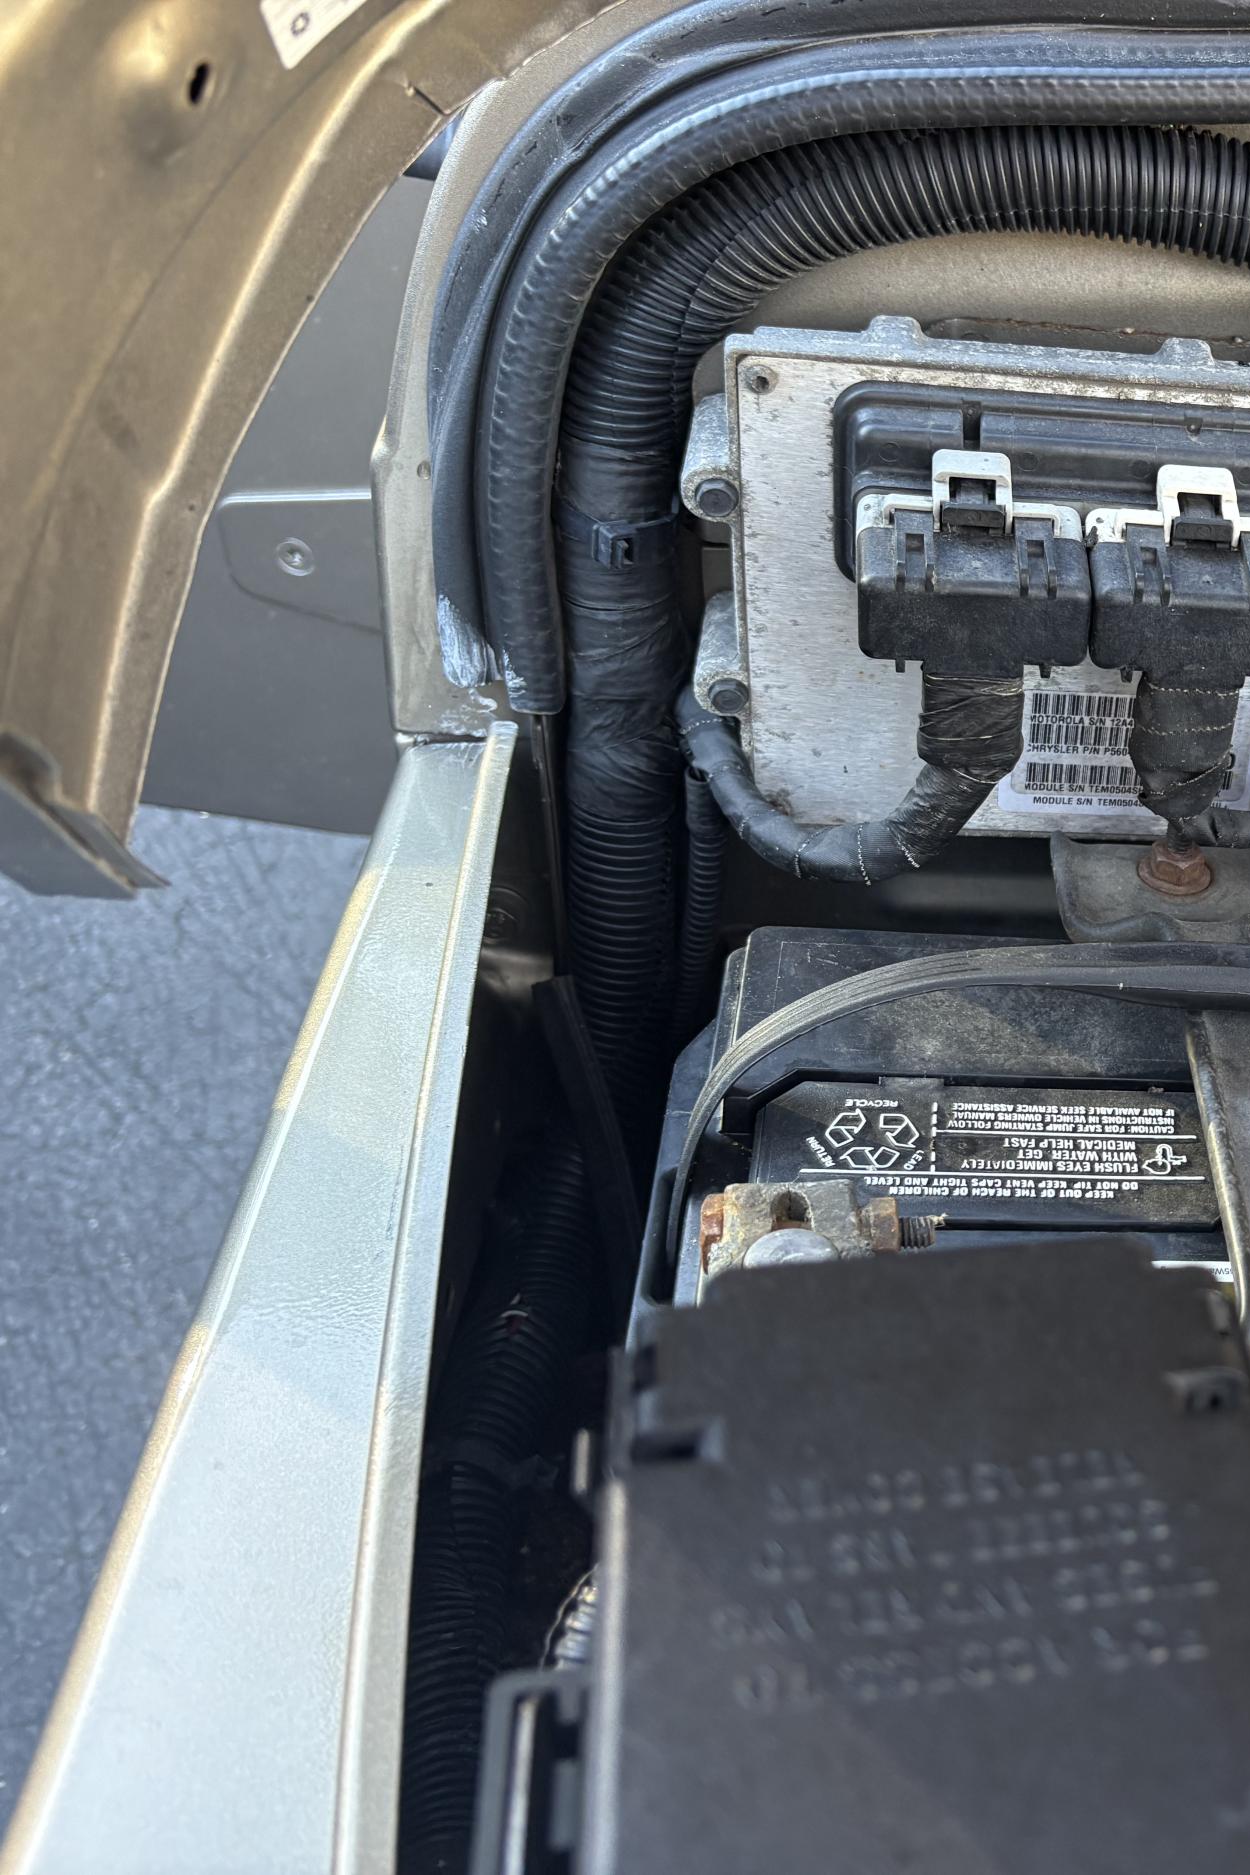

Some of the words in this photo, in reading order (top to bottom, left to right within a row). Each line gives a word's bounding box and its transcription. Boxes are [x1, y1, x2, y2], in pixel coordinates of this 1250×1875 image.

[1030, 715, 1084, 725] MOTOROLA
[1089, 717, 1106, 726] S/N
[1083, 746, 1100, 756] P/N
[1025, 783, 1064, 792] MODULE
[1068, 784, 1085, 793] S/N
[1033, 796, 1074, 806] MODULE
[1076, 797, 1093, 806] S/N
[844, 1098, 898, 1108] RECYCLE
[952, 1102, 1014, 1112] ASSISTANCE
[1016, 1104, 1058, 1113] SERVICE
[1060, 1106, 1086, 1114] SEEK
[1088, 1106, 1140, 1115] AVAILABLE
[1142, 1108, 1163, 1116] NOT
[1164, 1108, 1174, 1116] IF
[952, 1111, 995, 1120] MANUAL
[997, 1112, 1042, 1122] OWNERS
[1044, 1114, 1086, 1124] VEHICLE
[1088, 1116, 1100, 1124] IN
[946, 1120, 991, 1129] FOLLOW
[994, 1120, 1044, 1130] STARTING
[1101, 1116, 1174, 1125] INSTRUCTIONS
[1046, 1123, 1076, 1132] JUMP
[1078, 1124, 1102, 1132] SAFE
[1104, 1124, 1125, 1133] FOR
[1128, 1125, 1174, 1134] CAUTION:
[1002, 1137, 1036, 1148] FAST
[1039, 1138, 1074, 1149] HELP
[1076, 1139, 1136, 1150] MEDICAL
[804, 1135, 836, 1168] RETURN
[1016, 1148, 1043, 1159] GET
[903, 1149, 924, 1170] LEAD
[1102, 1151, 1138, 1162] WITH
[960, 1158, 1053, 1171] IMMEDIATELY
[1056, 1160, 1091, 1172] EYES
[1094, 1162, 1138, 1173] FLUSH
[864, 1176, 900, 1185] LEVEL
[904, 1177, 929, 1186] AND
[932, 1178, 968, 1186] TIGHT
[971, 1178, 1002, 1187] CAPS
[1005, 1179, 1035, 1188] VENT
[1038, 1180, 1067, 1188] KEEP
[1096, 1181, 1118, 1190] NOT
[1122, 1182, 1138, 1190] DO
[888, 1186, 950, 1195] CHILDREN
[952, 1187, 968, 1196] OF
[972, 1188, 1011, 1196] REACH
[1014, 1188, 1036, 1197] THE
[1040, 1189, 1056, 1198] OF
[1059, 1189, 1082, 1198] OUT
[1084, 1190, 1114, 1198] KEEP
